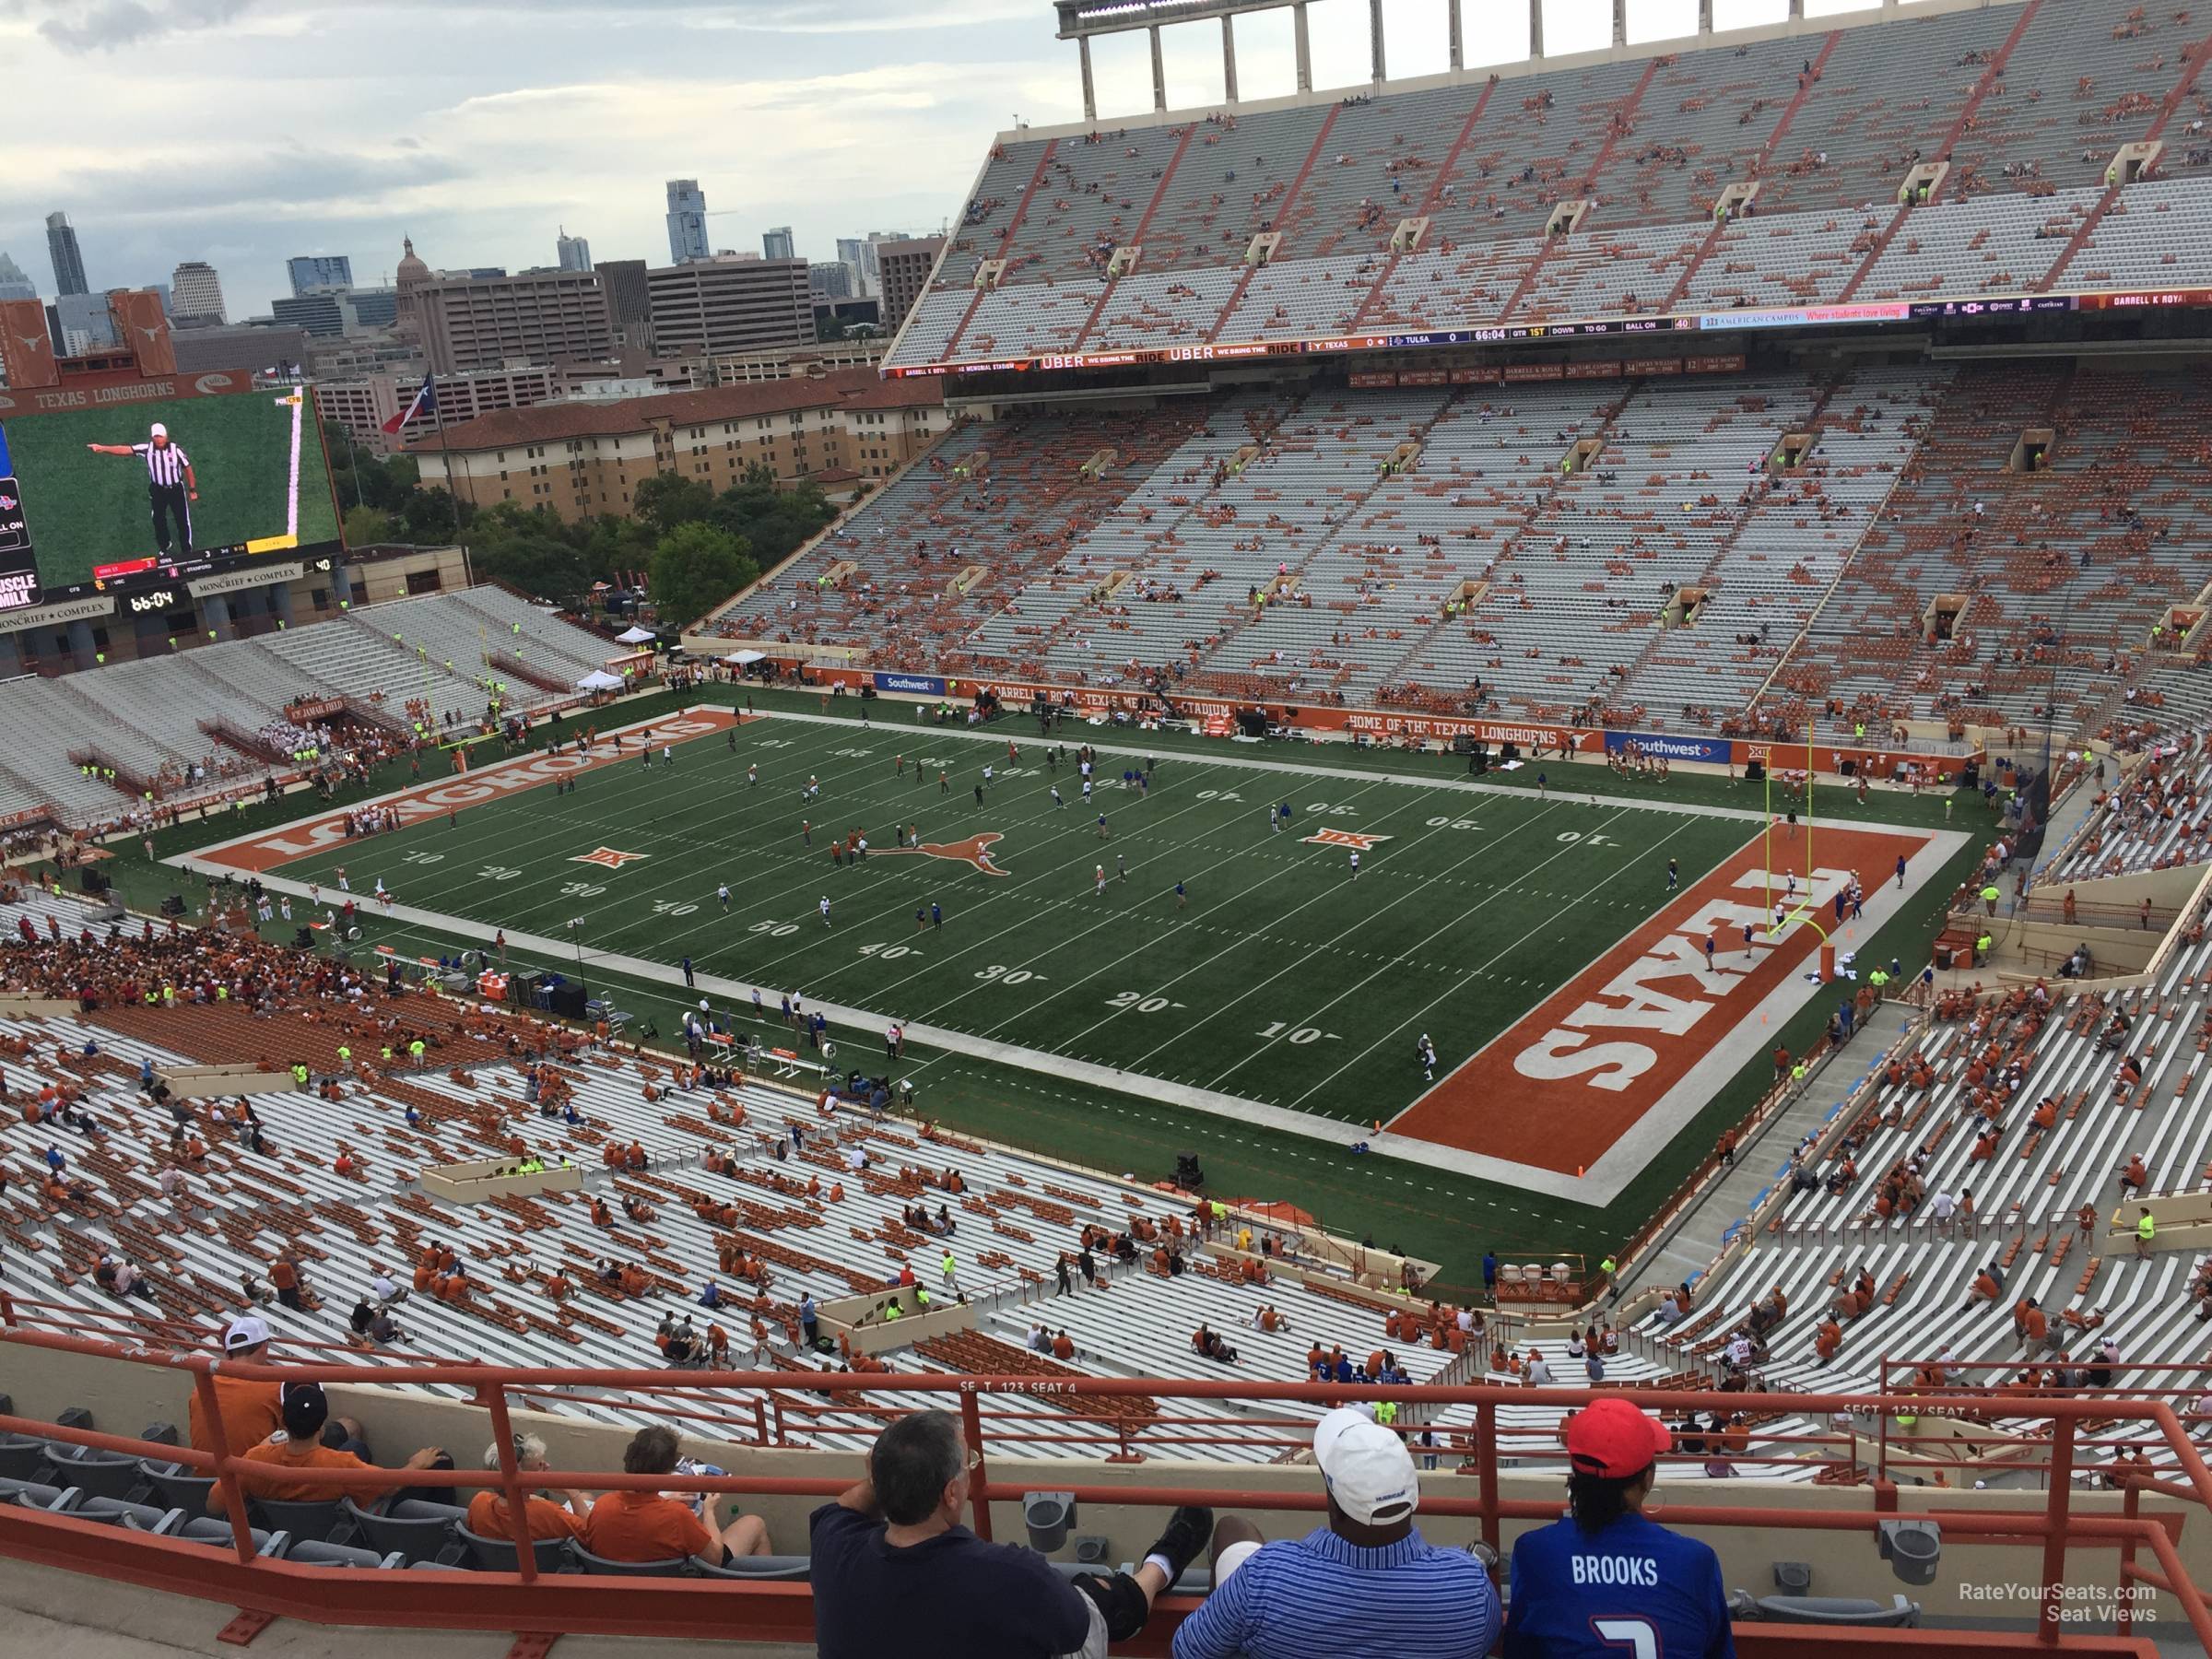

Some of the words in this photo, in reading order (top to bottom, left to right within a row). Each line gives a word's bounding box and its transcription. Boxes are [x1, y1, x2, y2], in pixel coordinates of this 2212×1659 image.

[2114, 296, 2149, 306] DARRELL
[2153, 296, 2158, 304] K
[1720, 317, 1763, 325] AMERICAN
[1765, 314, 1799, 323] CAMPUS
[1806, 311, 1828, 320] Where
[1831, 310, 1861, 319] students
[1863, 309, 1878, 318] love
[1676, 319, 1688, 327] 40
[1450, 333, 1456, 342] 0
[1475, 329, 1505, 340] 66:04
[1529, 328, 1544, 336] 1ST
[1367, 339, 1373, 347] 0
[1171, 348, 1213, 360] UBER
[1267, 343, 1298, 355] RIDE
[1043, 356, 1084, 369] UBER
[1136, 353, 1165, 364] RIDE
[1688, 361, 1696, 369] 12
[35, 390, 87, 409] TEXAS
[94, 382, 175, 403] LONGHORNS
[0, 523, 8, 531] LL
[9, 521, 23, 530] ON
[316, 559, 331, 571] 40
[0, 574, 36, 590] USCLE
[198, 579, 245, 593] MONCRIEF
[254, 568, 296, 582] COMPLEX
[0, 589, 31, 608] MILK
[0, 613, 46, 629] ONCRIEF
[57, 603, 105, 618] COMPLEX
[888, 677, 930, 691] Southwest
[1050, 691, 1117, 707] ROL-TEXS
[303, 706, 325, 717] JAMAIL
[325, 700, 343, 712] FIELD
[1349, 715, 1382, 730] HOME
[1386, 718, 1401, 731] OF
[1405, 719, 1429, 734] THE
[1433, 722, 1475, 738] TEXAS
[1481, 725, 1557, 745] LONGHORNS
[759, 740, 795, 749] 10
[836, 748, 873, 758] 20
[1002, 768, 1041, 778] 40
[258, 719, 718, 856] LONGHORNS
[1195, 788, 1240, 802] 40
[1305, 802, 1353, 816] 30
[1425, 816, 1477, 830] 20
[1557, 831, 1613, 846] 10
[403, 852, 445, 865] 10
[477, 866, 523, 880] 20
[560, 882, 606, 898] 30
[652, 900, 699, 917] 40
[748, 920, 800, 937] 50
[857, 942, 911, 960] 40
[974, 965, 1032, 985] 30
[1513, 868, 1851, 1091] TEXAS
[1105, 991, 1169, 1012] 20
[1255, 1021, 1322, 1045] 10
[959, 1381, 994, 1393] SET.
[1001, 1382, 1024, 1393] 123
[1031, 1382, 1062, 1393] SEAT
[1068, 1383, 1076, 1394] 4
[1843, 1404, 1880, 1415] SECT
[1973, 1408, 1980, 1416] 1
[1571, 1555, 1658, 1586] BROOKS
